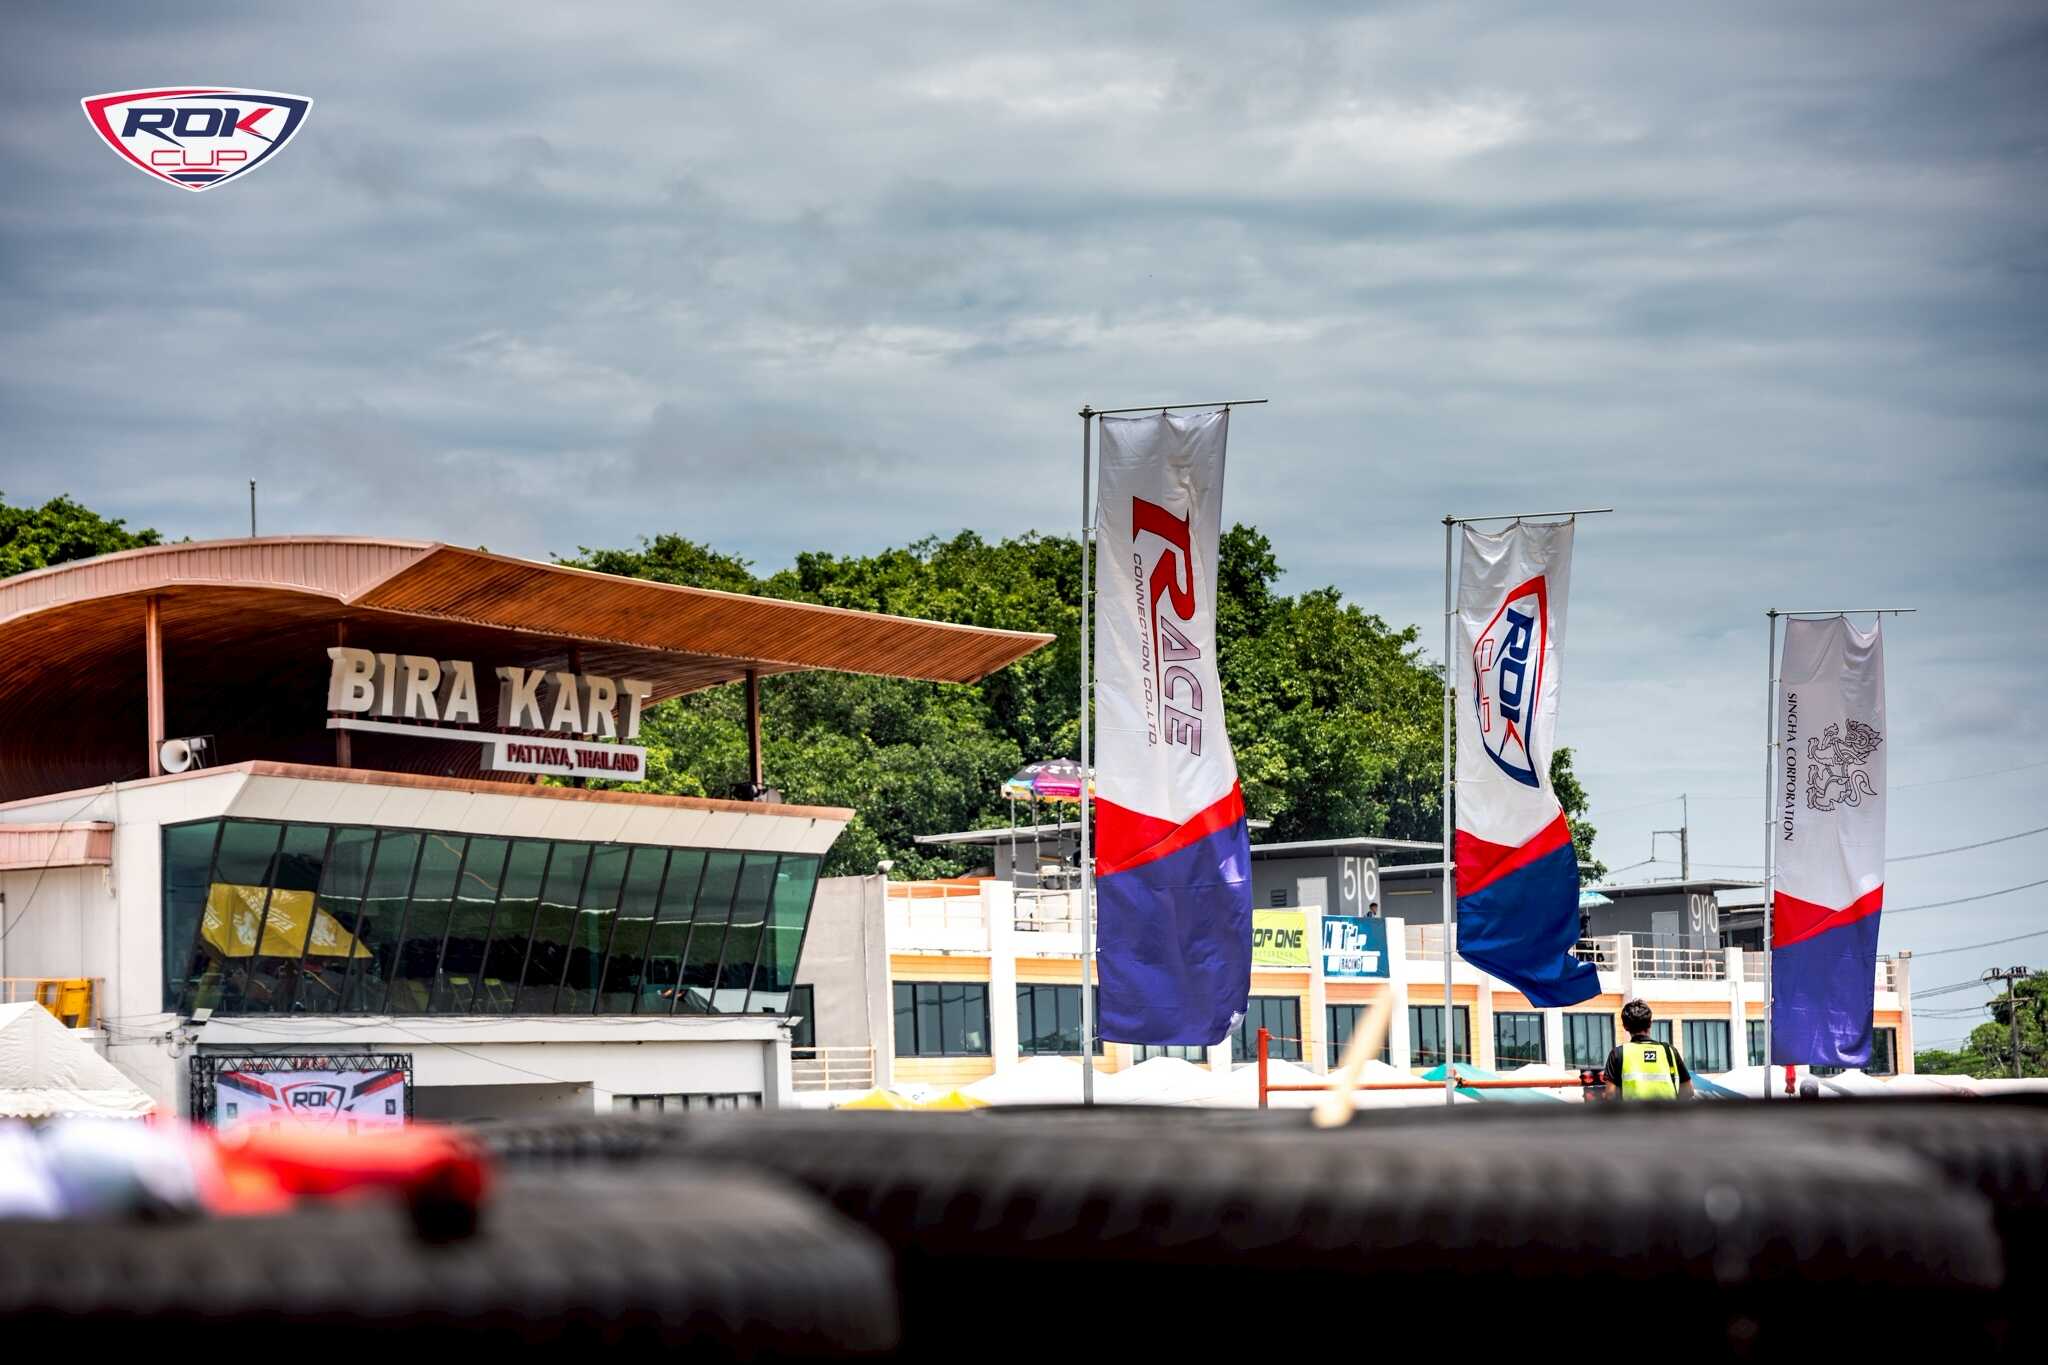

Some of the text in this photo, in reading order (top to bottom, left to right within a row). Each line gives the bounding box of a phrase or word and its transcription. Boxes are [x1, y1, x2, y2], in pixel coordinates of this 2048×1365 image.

[1133, 552, 1151, 672] CONNECTION
[327, 647, 652, 739] BIRA KART
[1493, 608, 1535, 753] ROK
[507, 743, 640, 772] PATTAYA, THAILAND
[1784, 692, 1798, 842] SINGHA CORPORATION
[1252, 928, 1273, 948] OP
[1274, 929, 1303, 948] ONE
[1644, 1052, 1656, 1061] 22
[293, 1090, 337, 1112] ROK
